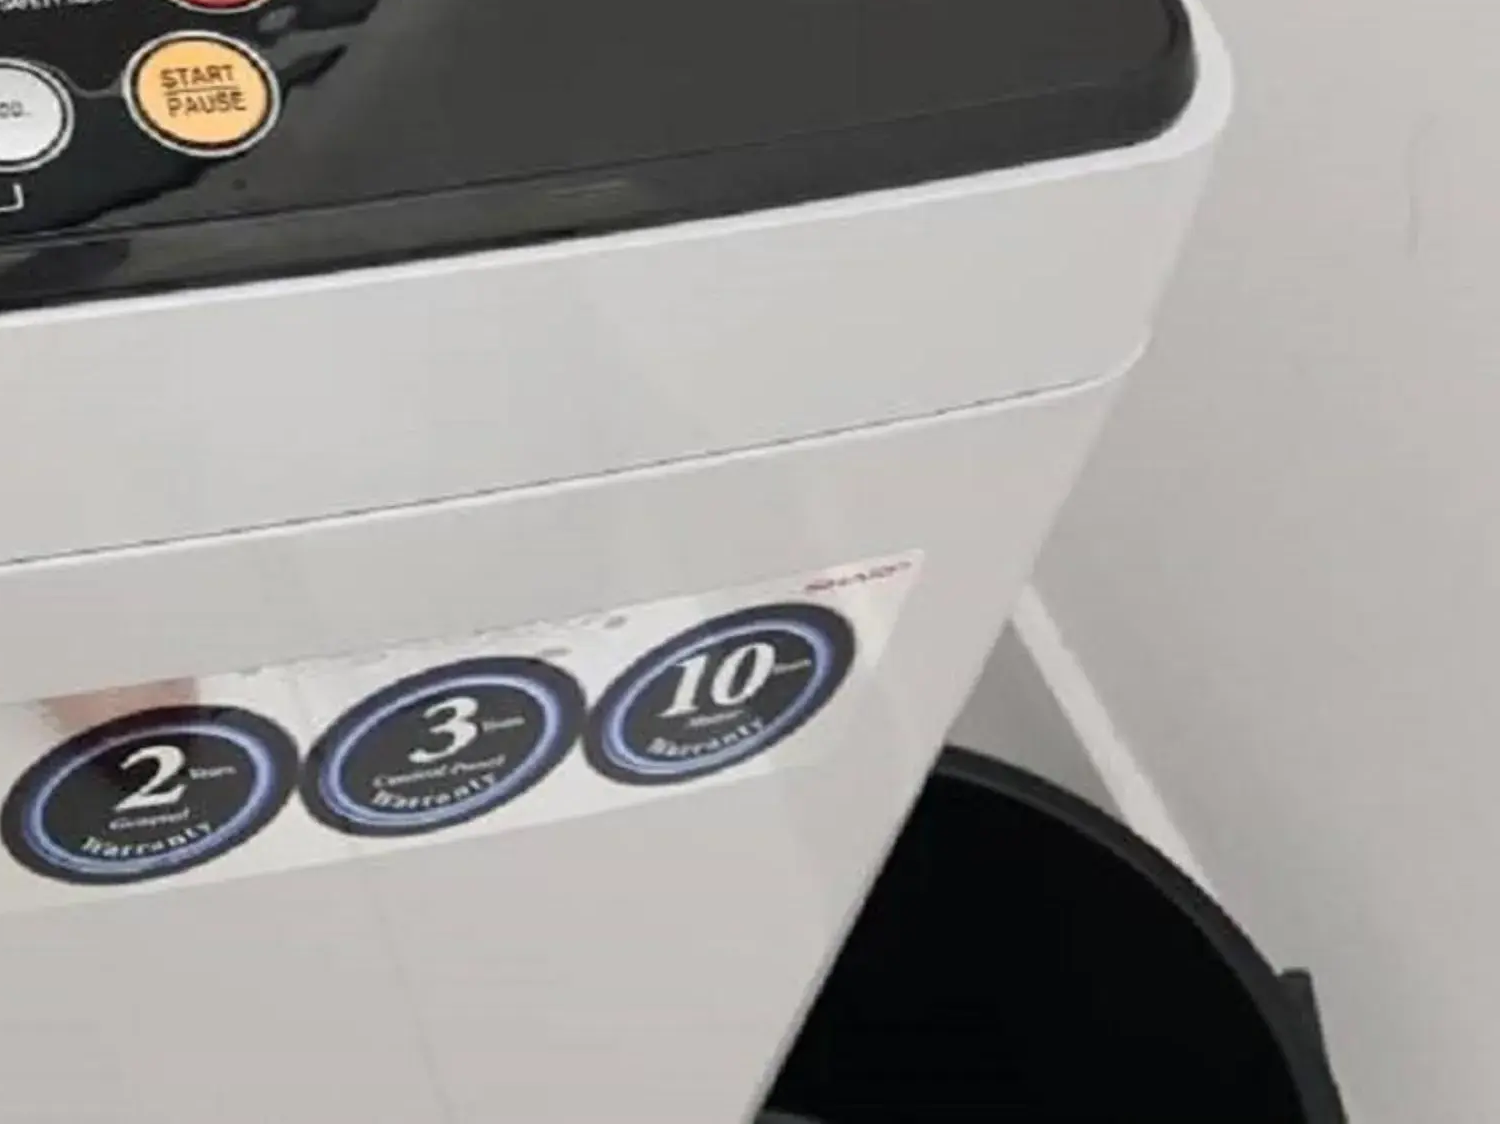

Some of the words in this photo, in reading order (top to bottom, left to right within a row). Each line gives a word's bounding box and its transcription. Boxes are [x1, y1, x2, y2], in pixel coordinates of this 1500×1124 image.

[160, 64, 235, 90] START
[166, 89, 248, 118] PAUSE
[657, 641, 777, 717] 10
[408, 696, 479, 763] 3
[113, 744, 188, 812] 2
